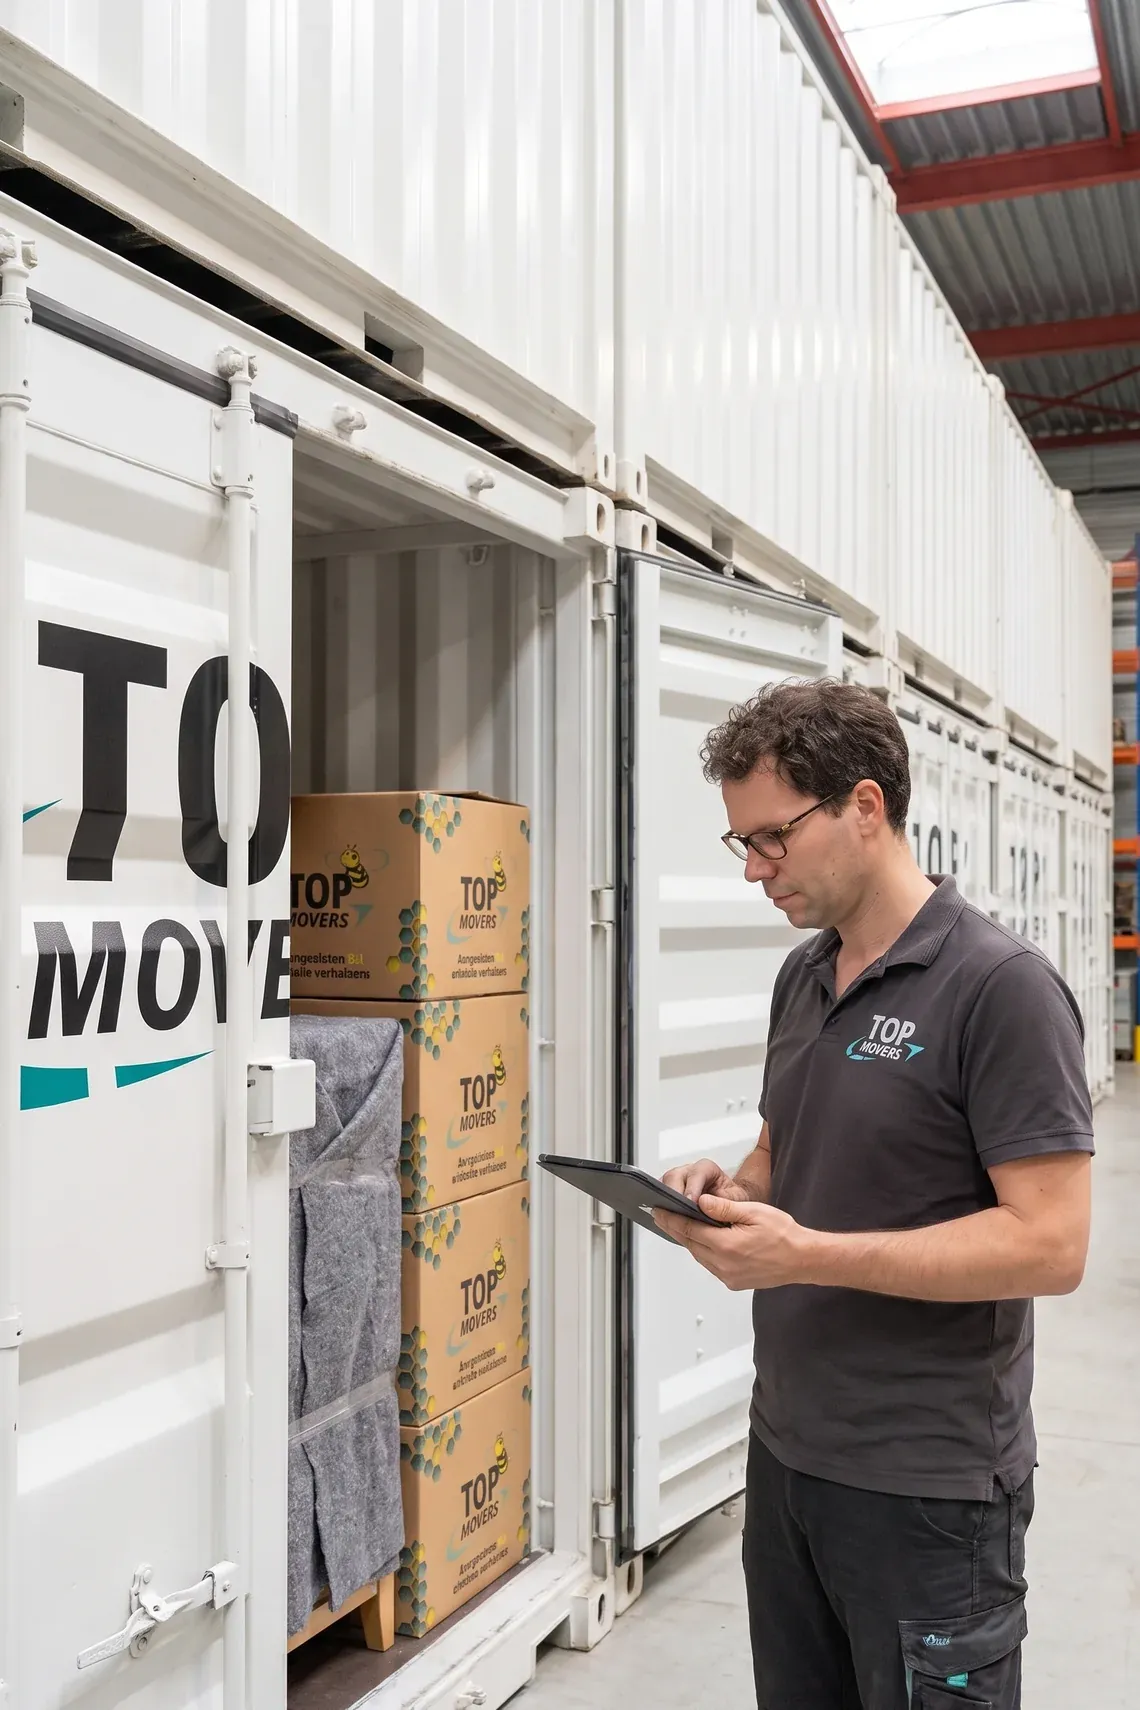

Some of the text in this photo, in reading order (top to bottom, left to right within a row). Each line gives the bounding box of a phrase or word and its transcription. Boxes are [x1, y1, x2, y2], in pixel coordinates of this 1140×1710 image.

[461, 876, 498, 911] TOP
[459, 915, 497, 929] MOVERS
[868, 1014, 916, 1046] TOP
[859, 1040, 902, 1060] MOVERS
[460, 1073, 496, 1112] TOP
[459, 1109, 497, 1132] MOVERS
[460, 1269, 498, 1315] TOP
[460, 1305, 497, 1337] MOVERS
[461, 1464, 498, 1518] TOP
[460, 1500, 499, 1541] MOVERS
